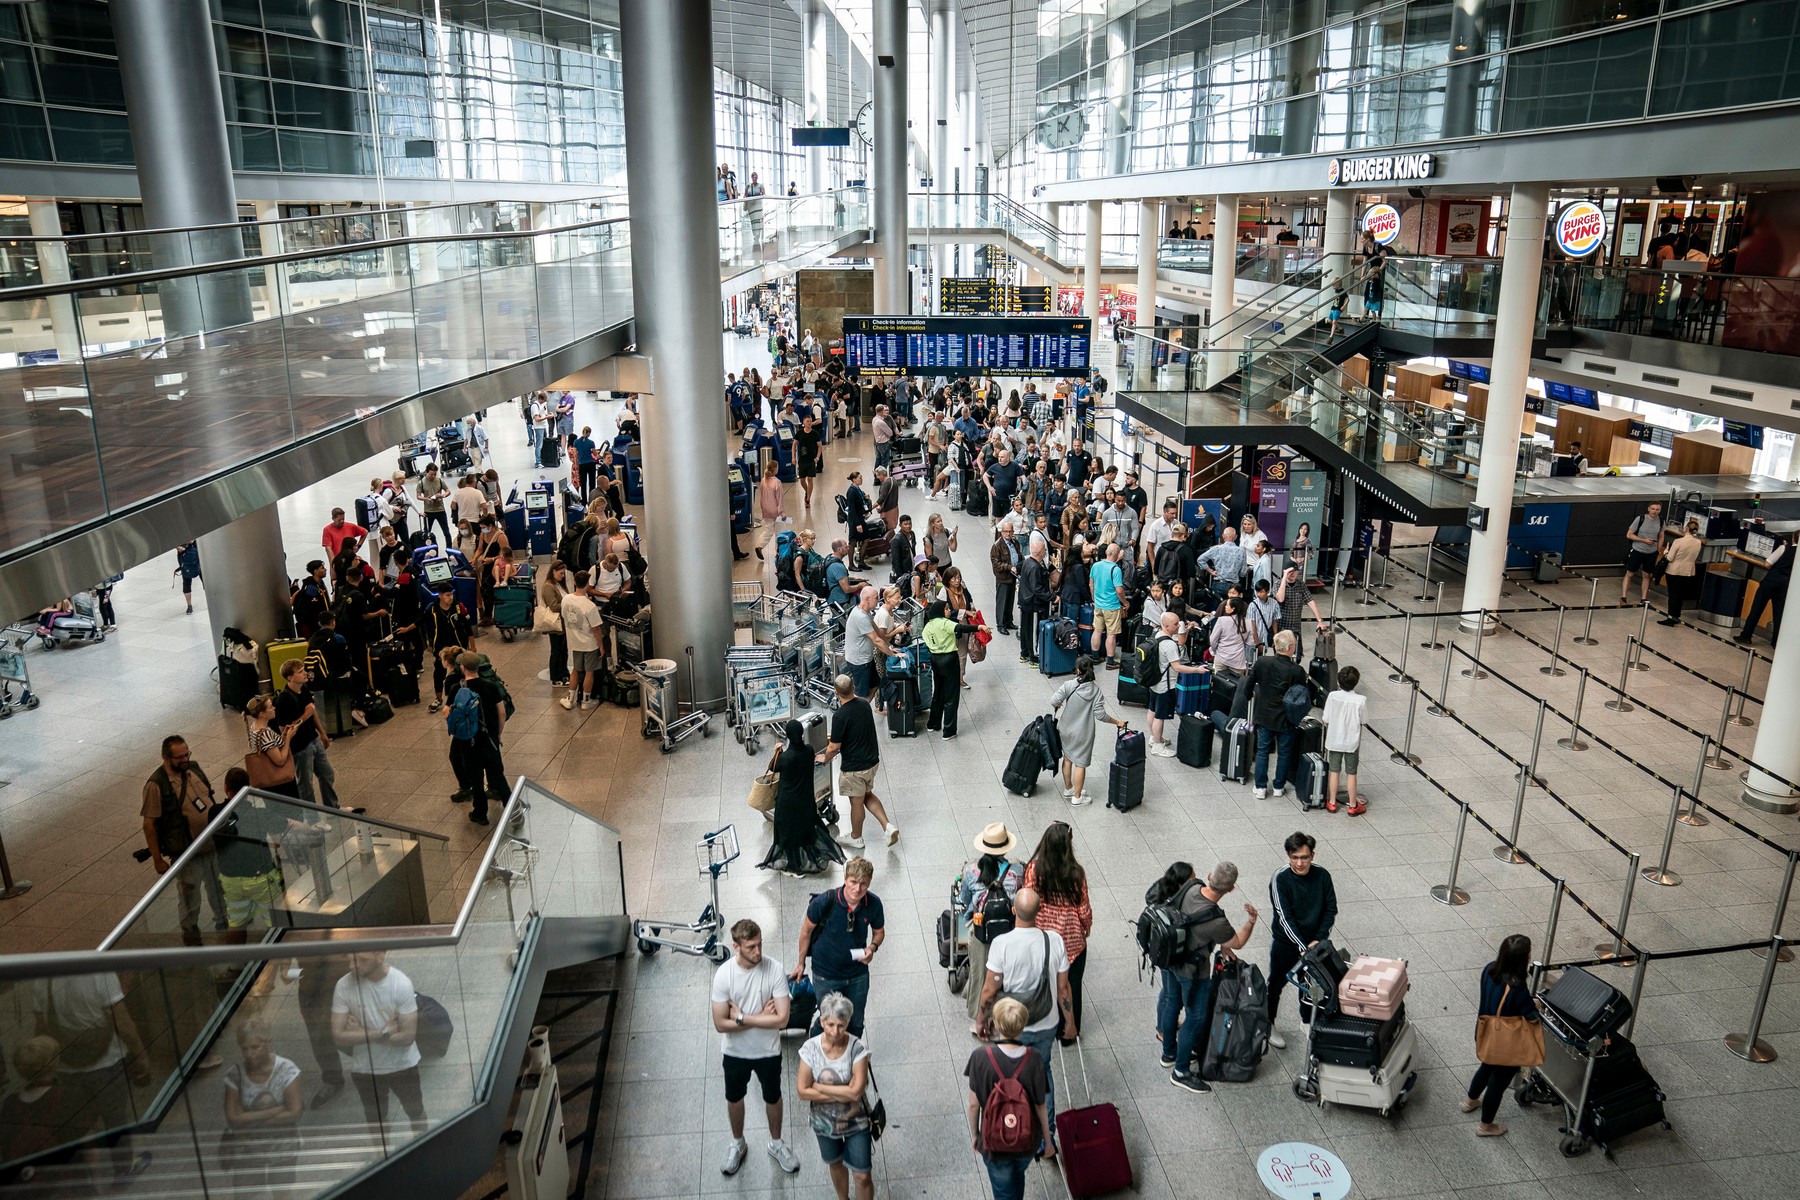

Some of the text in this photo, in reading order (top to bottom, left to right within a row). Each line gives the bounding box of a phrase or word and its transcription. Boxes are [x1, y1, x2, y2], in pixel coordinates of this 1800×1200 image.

[1342, 158, 1393, 182] BURGER
[1393, 153, 1431, 179] KING
[1367, 212, 1396, 226] BURGER
[1368, 219, 1397, 234] KING
[1563, 213, 1600, 231] BURGER
[1563, 222, 1601, 244] KING
[736, 388, 742, 397] 9
[1528, 516, 1550, 525] SAS
